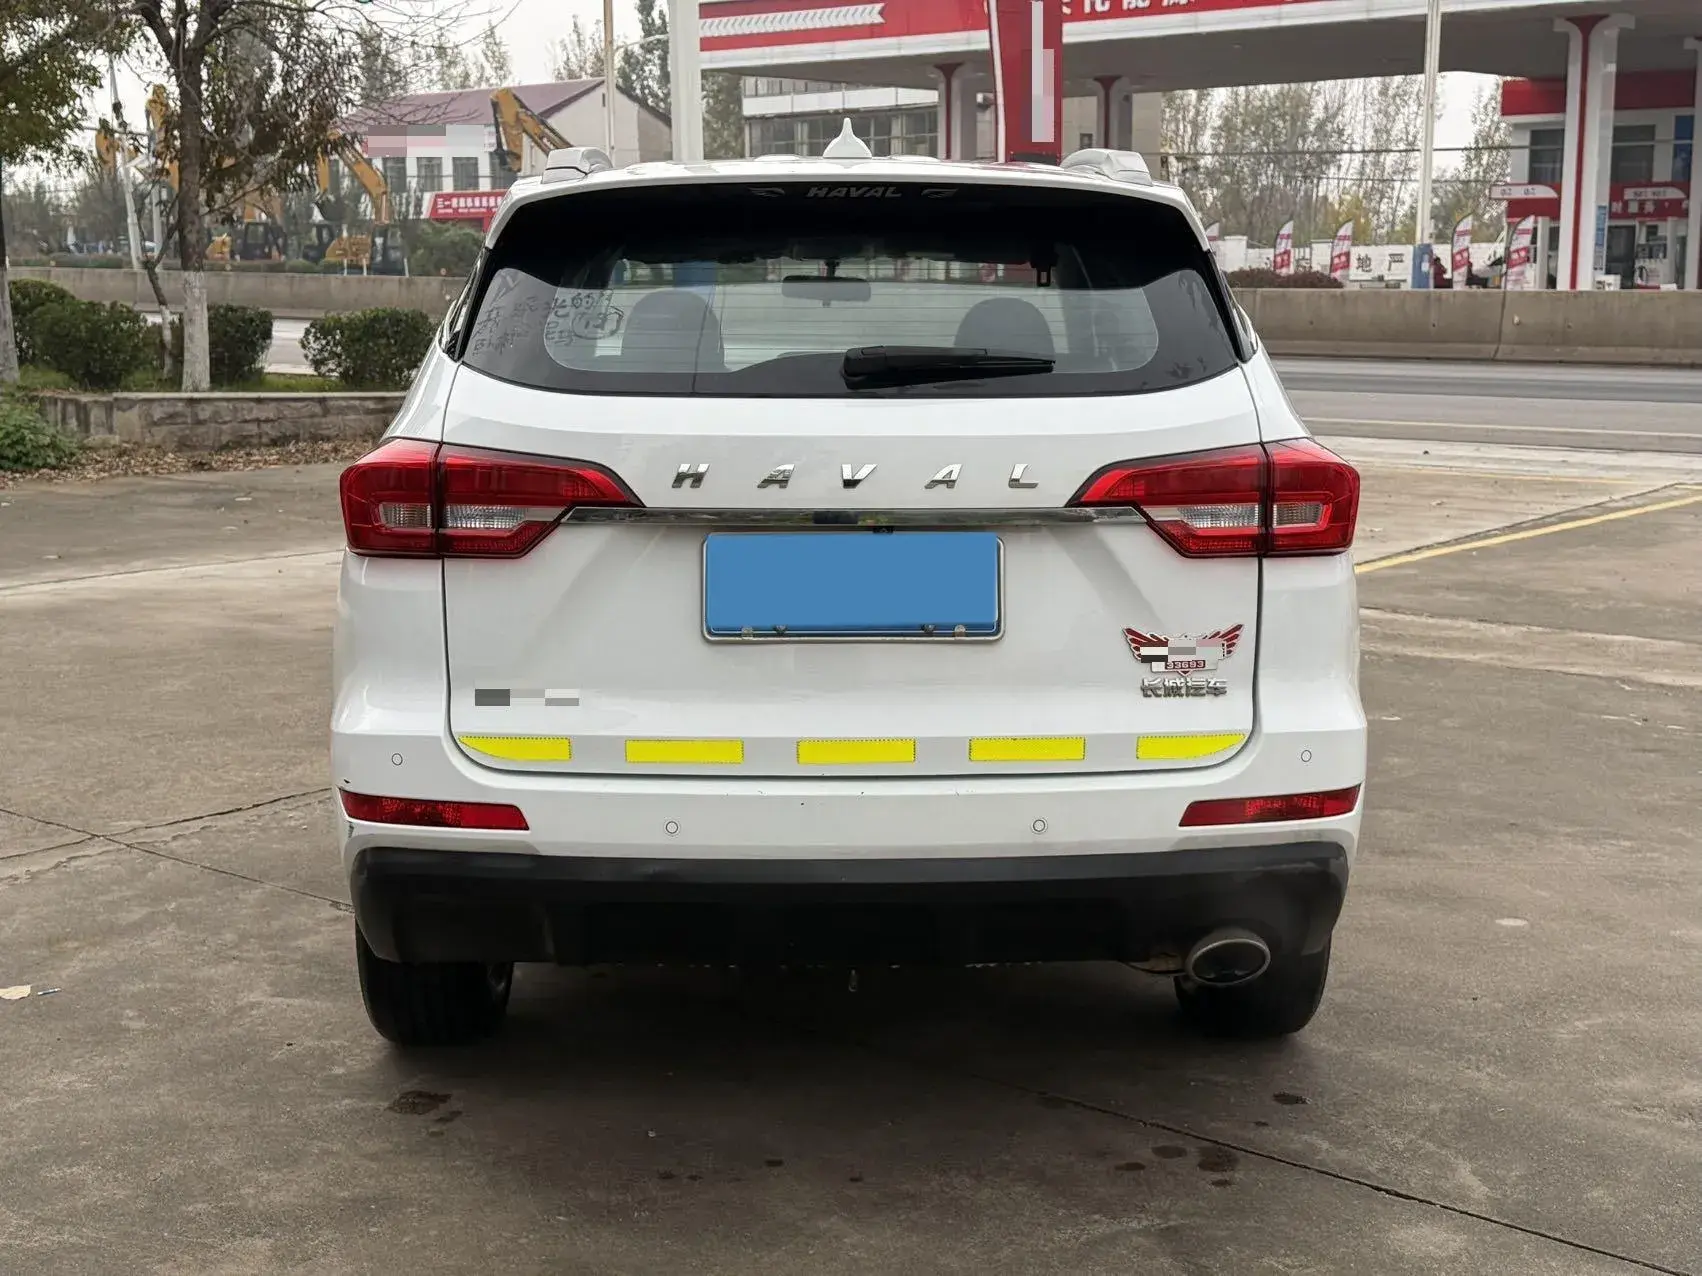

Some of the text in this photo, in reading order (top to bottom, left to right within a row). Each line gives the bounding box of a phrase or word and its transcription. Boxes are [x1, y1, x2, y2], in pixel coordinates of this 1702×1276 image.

[806, 187, 902, 198] HAVAL
[671, 463, 1040, 489] HAVAL
[1141, 678, 1228, 698] 长城汽车
